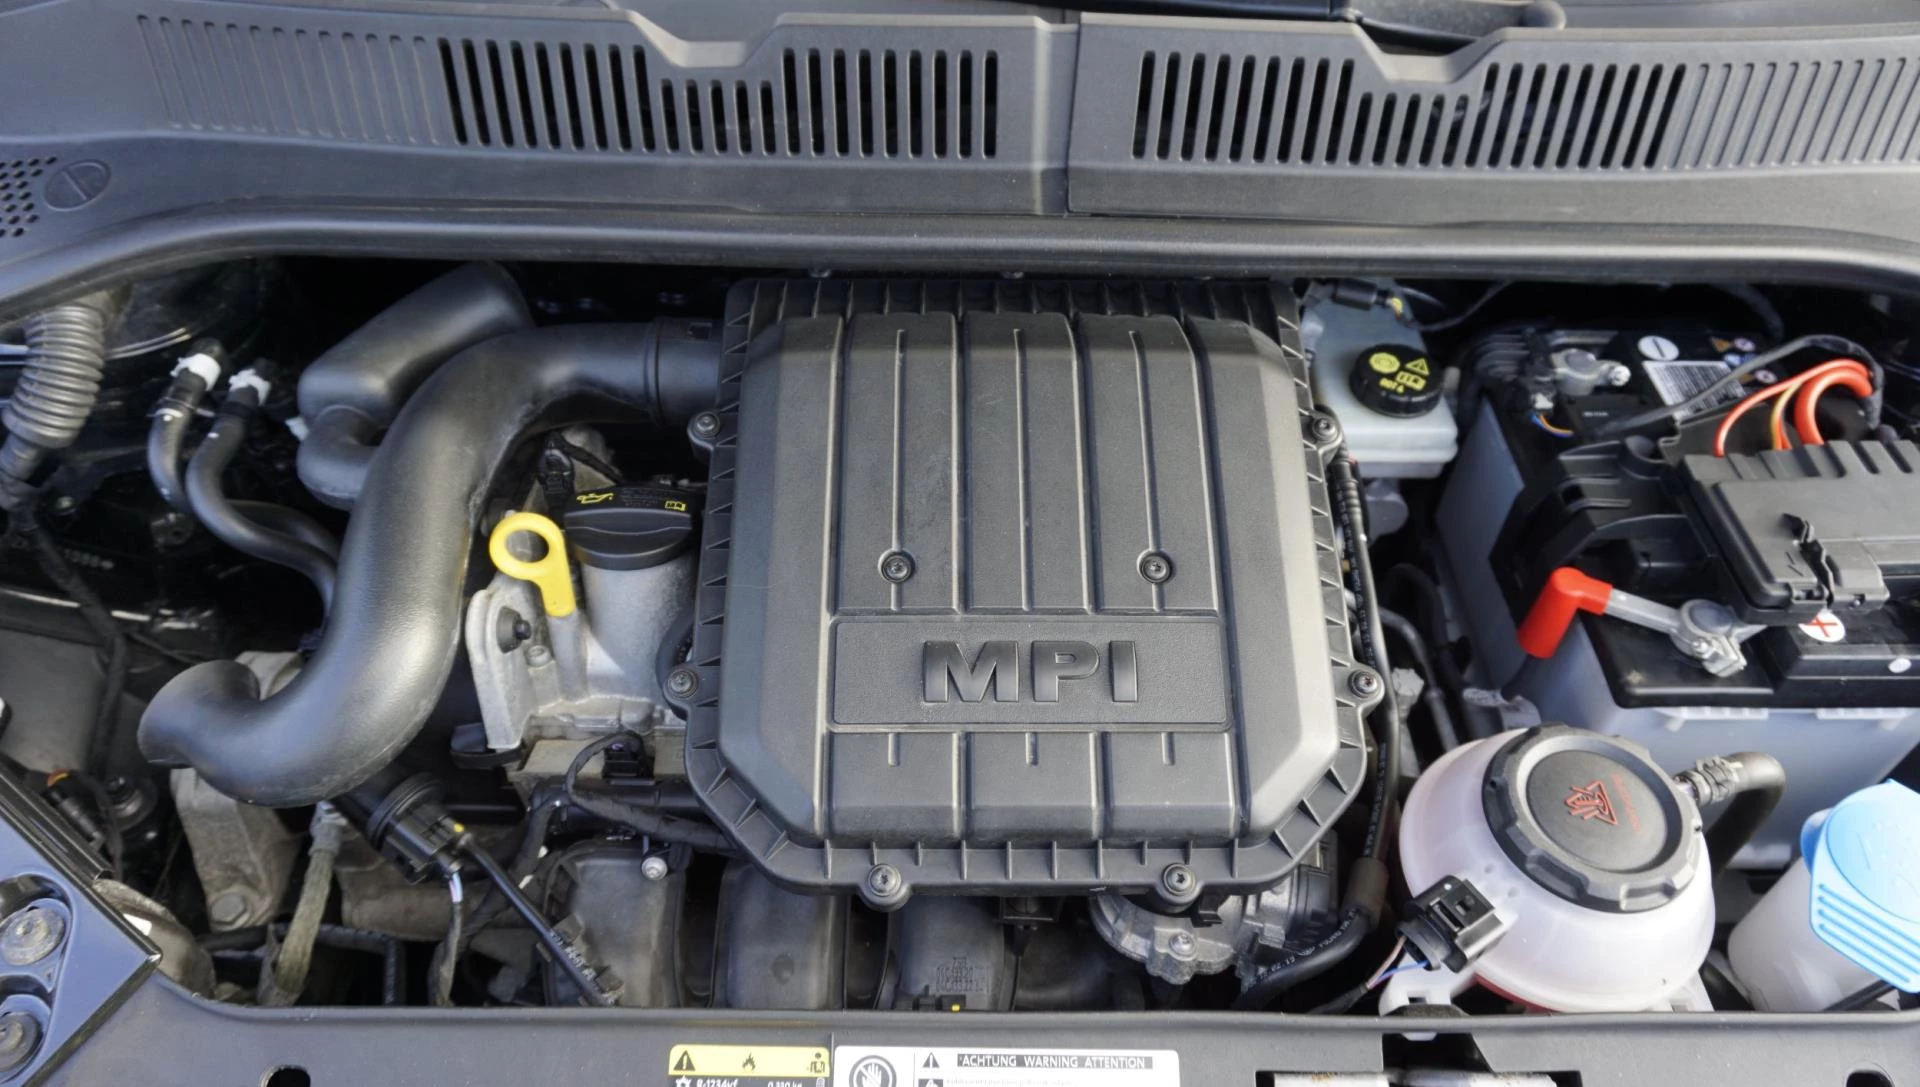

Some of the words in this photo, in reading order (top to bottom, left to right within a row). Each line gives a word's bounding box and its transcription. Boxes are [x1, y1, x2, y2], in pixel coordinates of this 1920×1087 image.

[923, 640, 1139, 704] MPI
[961, 1055, 1017, 1067] ACHTUNG
[1023, 1056, 1079, 1068] WARNING
[1084, 1057, 1146, 1069] ATTENTION
